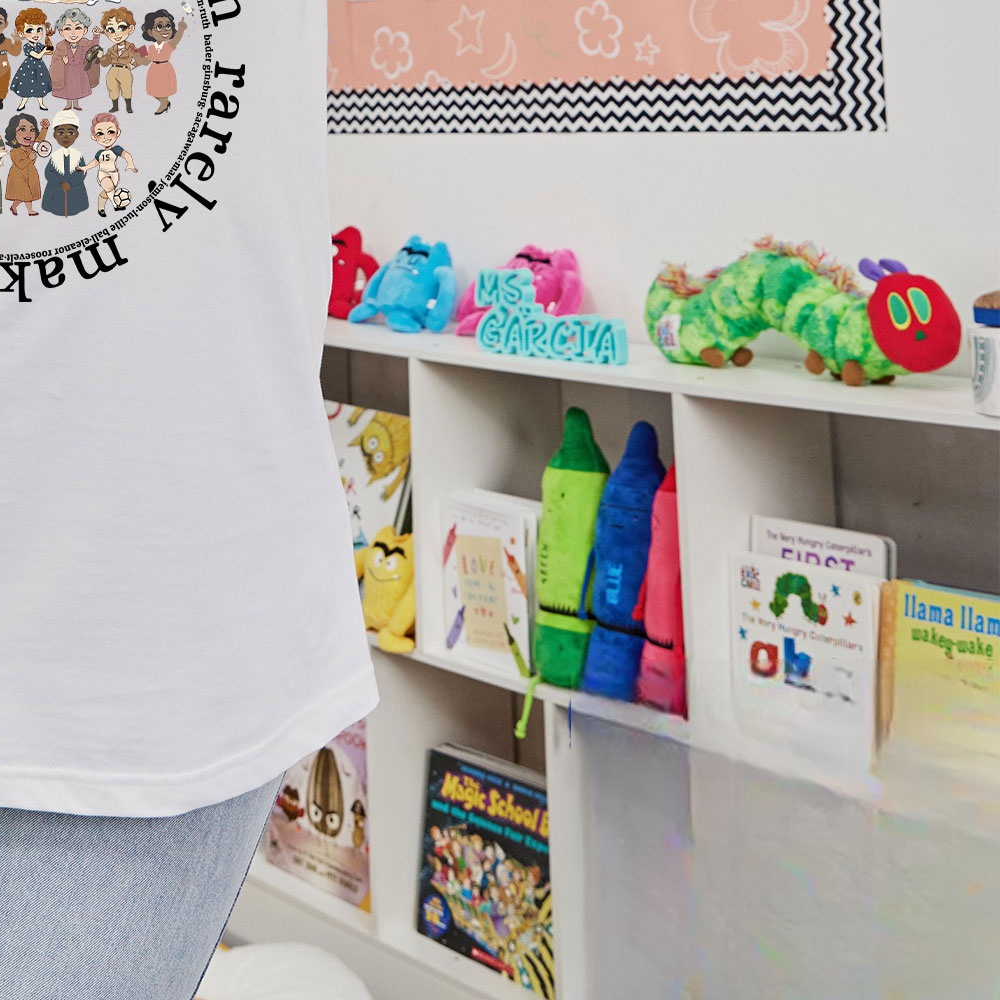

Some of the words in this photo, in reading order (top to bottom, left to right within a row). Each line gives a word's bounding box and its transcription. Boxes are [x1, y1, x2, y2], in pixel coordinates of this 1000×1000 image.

[204, 34, 213, 62] bader
[149, 61, 245, 232] rarely
[480, 308, 619, 365] GARCIA
[904, 593, 954, 628] llama
[911, 627, 994, 657] wakey-wake
[441, 772, 487, 811] Magic
[487, 788, 540, 832] School
